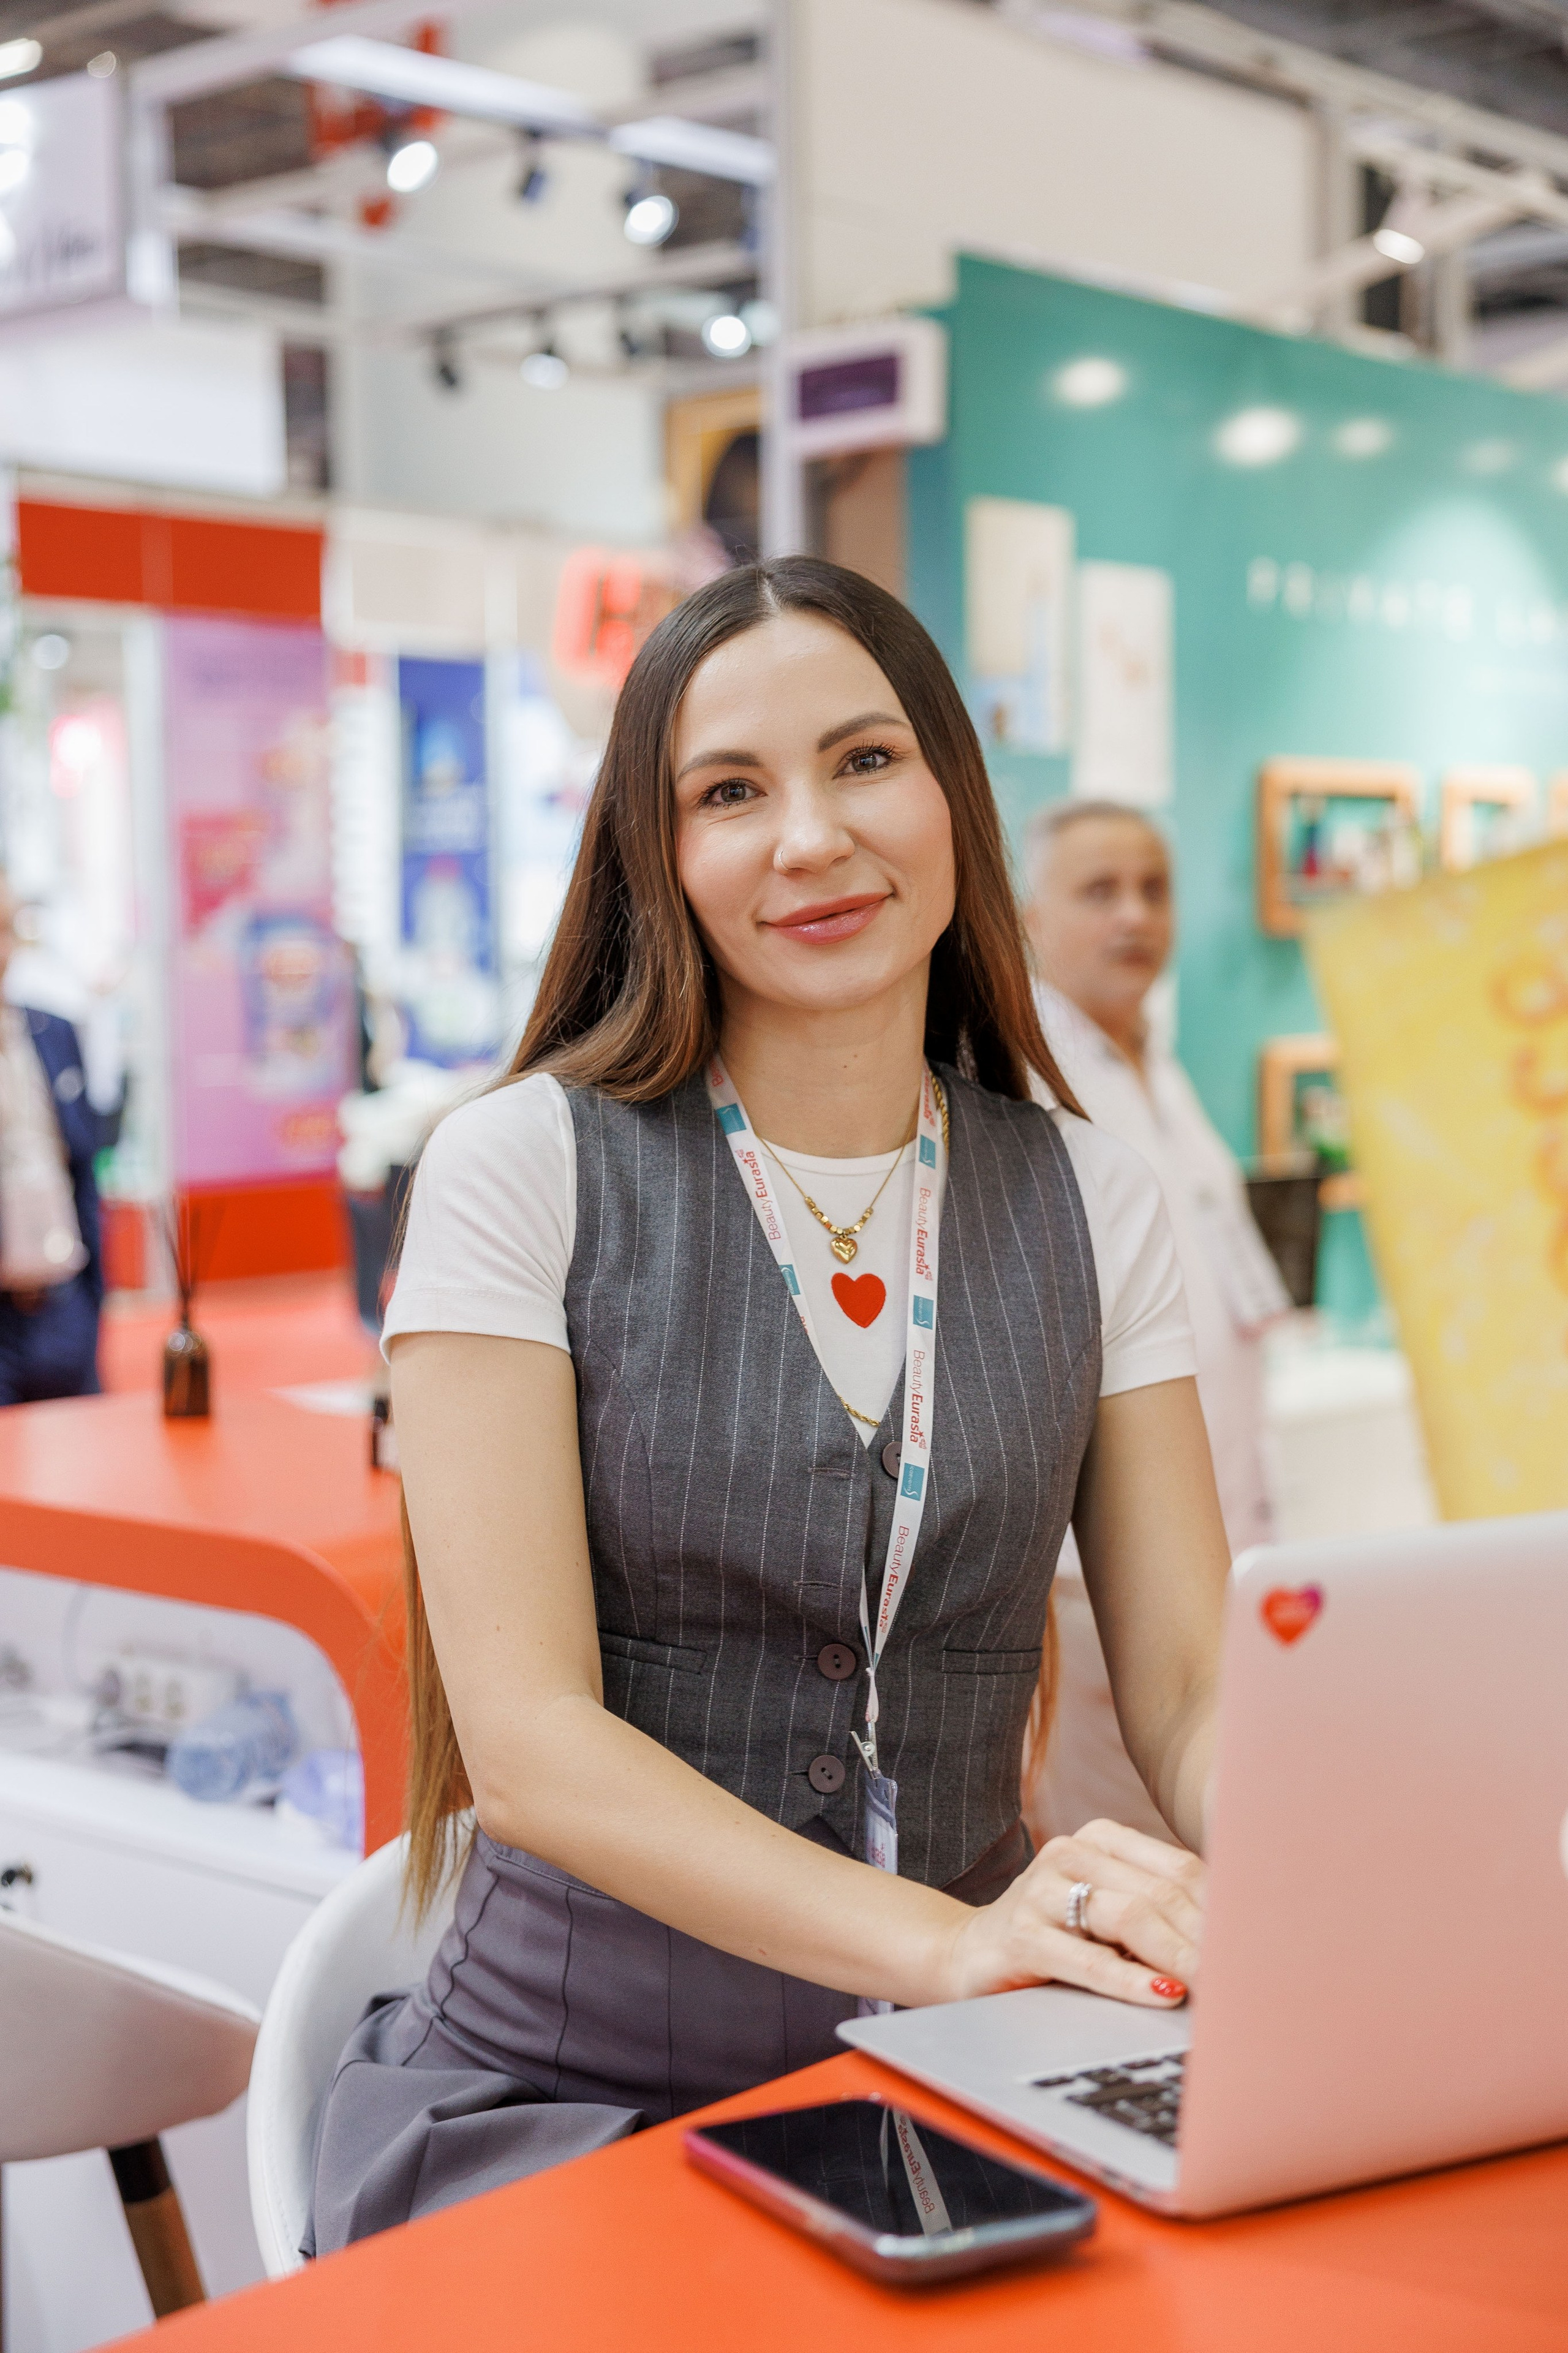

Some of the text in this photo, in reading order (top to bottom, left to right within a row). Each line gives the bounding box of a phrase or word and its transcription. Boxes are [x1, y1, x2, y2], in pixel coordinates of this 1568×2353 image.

[743, 1150, 781, 1241] BeautyEurasia
[916, 1187, 931, 1275] BeautyEurasia
[910, 1350, 925, 1443] BeautyEurasia
[879, 1525, 910, 1628] BeautyEurasia
